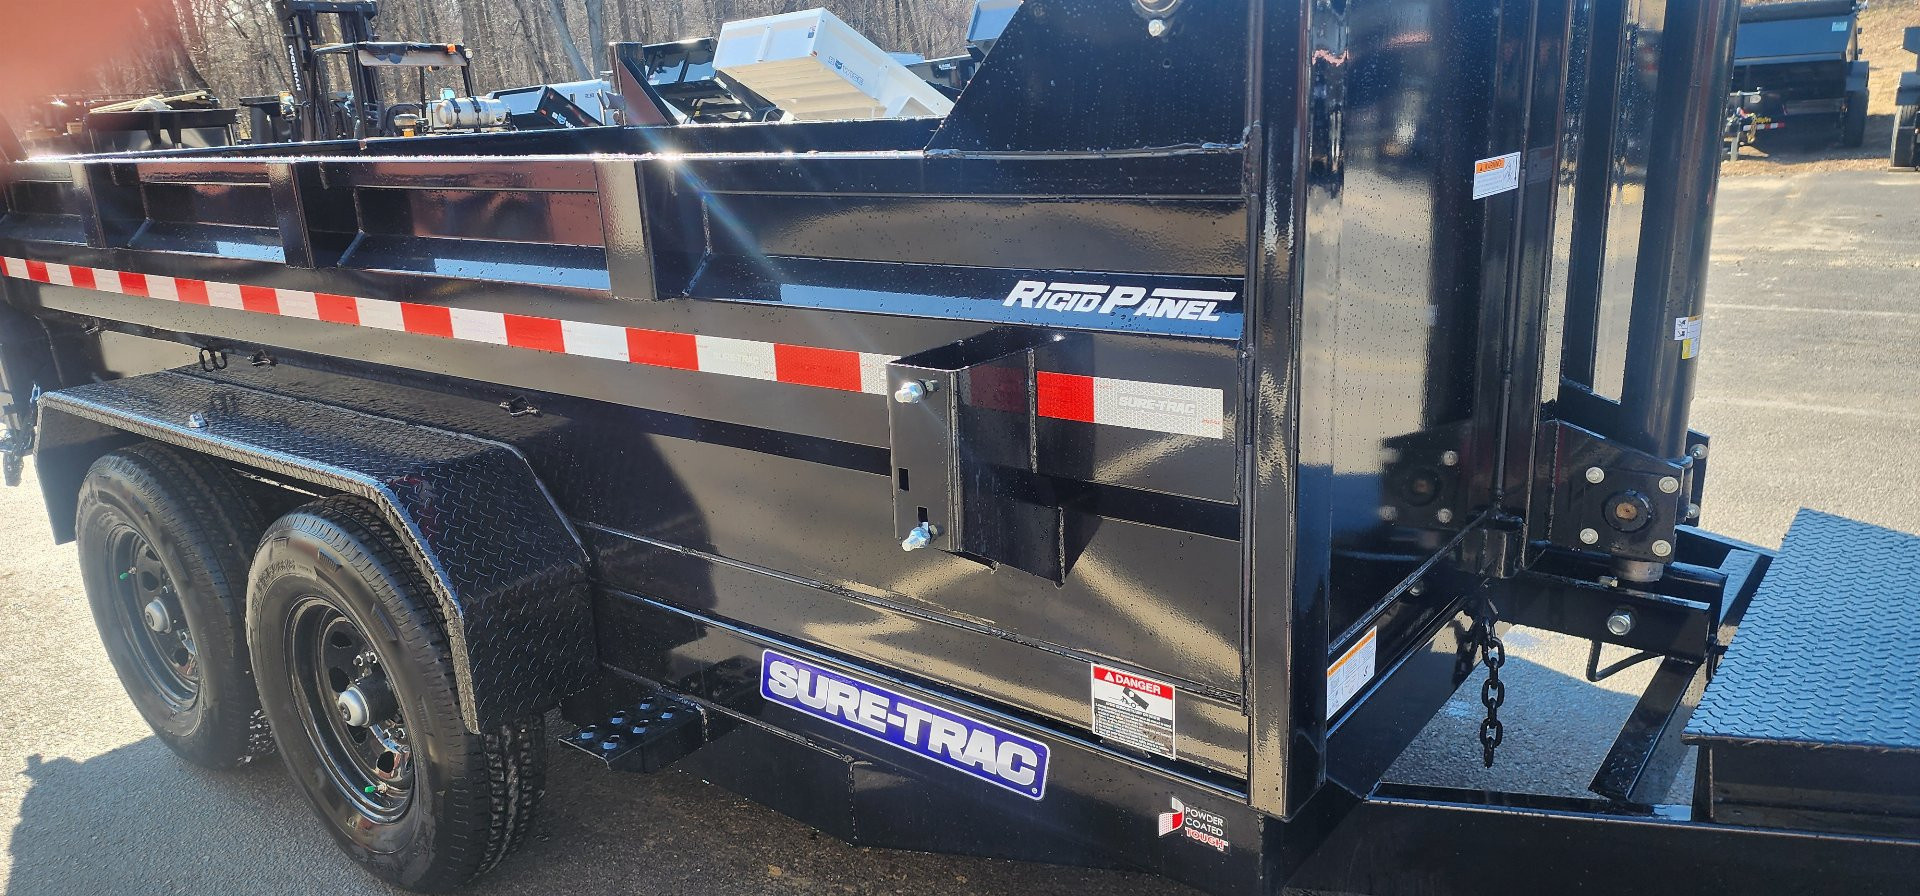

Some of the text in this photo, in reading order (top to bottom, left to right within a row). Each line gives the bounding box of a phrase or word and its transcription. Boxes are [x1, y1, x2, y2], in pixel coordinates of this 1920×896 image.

[288, 45, 301, 91] HYUNDAI
[1002, 280, 1237, 322] RIGID PANEL
[1115, 674, 1160, 694] DANGER
[766, 661, 1037, 787] SURE-TRAC
[1186, 807, 1223, 827] POWDER
[1186, 818, 1223, 837] COATED
